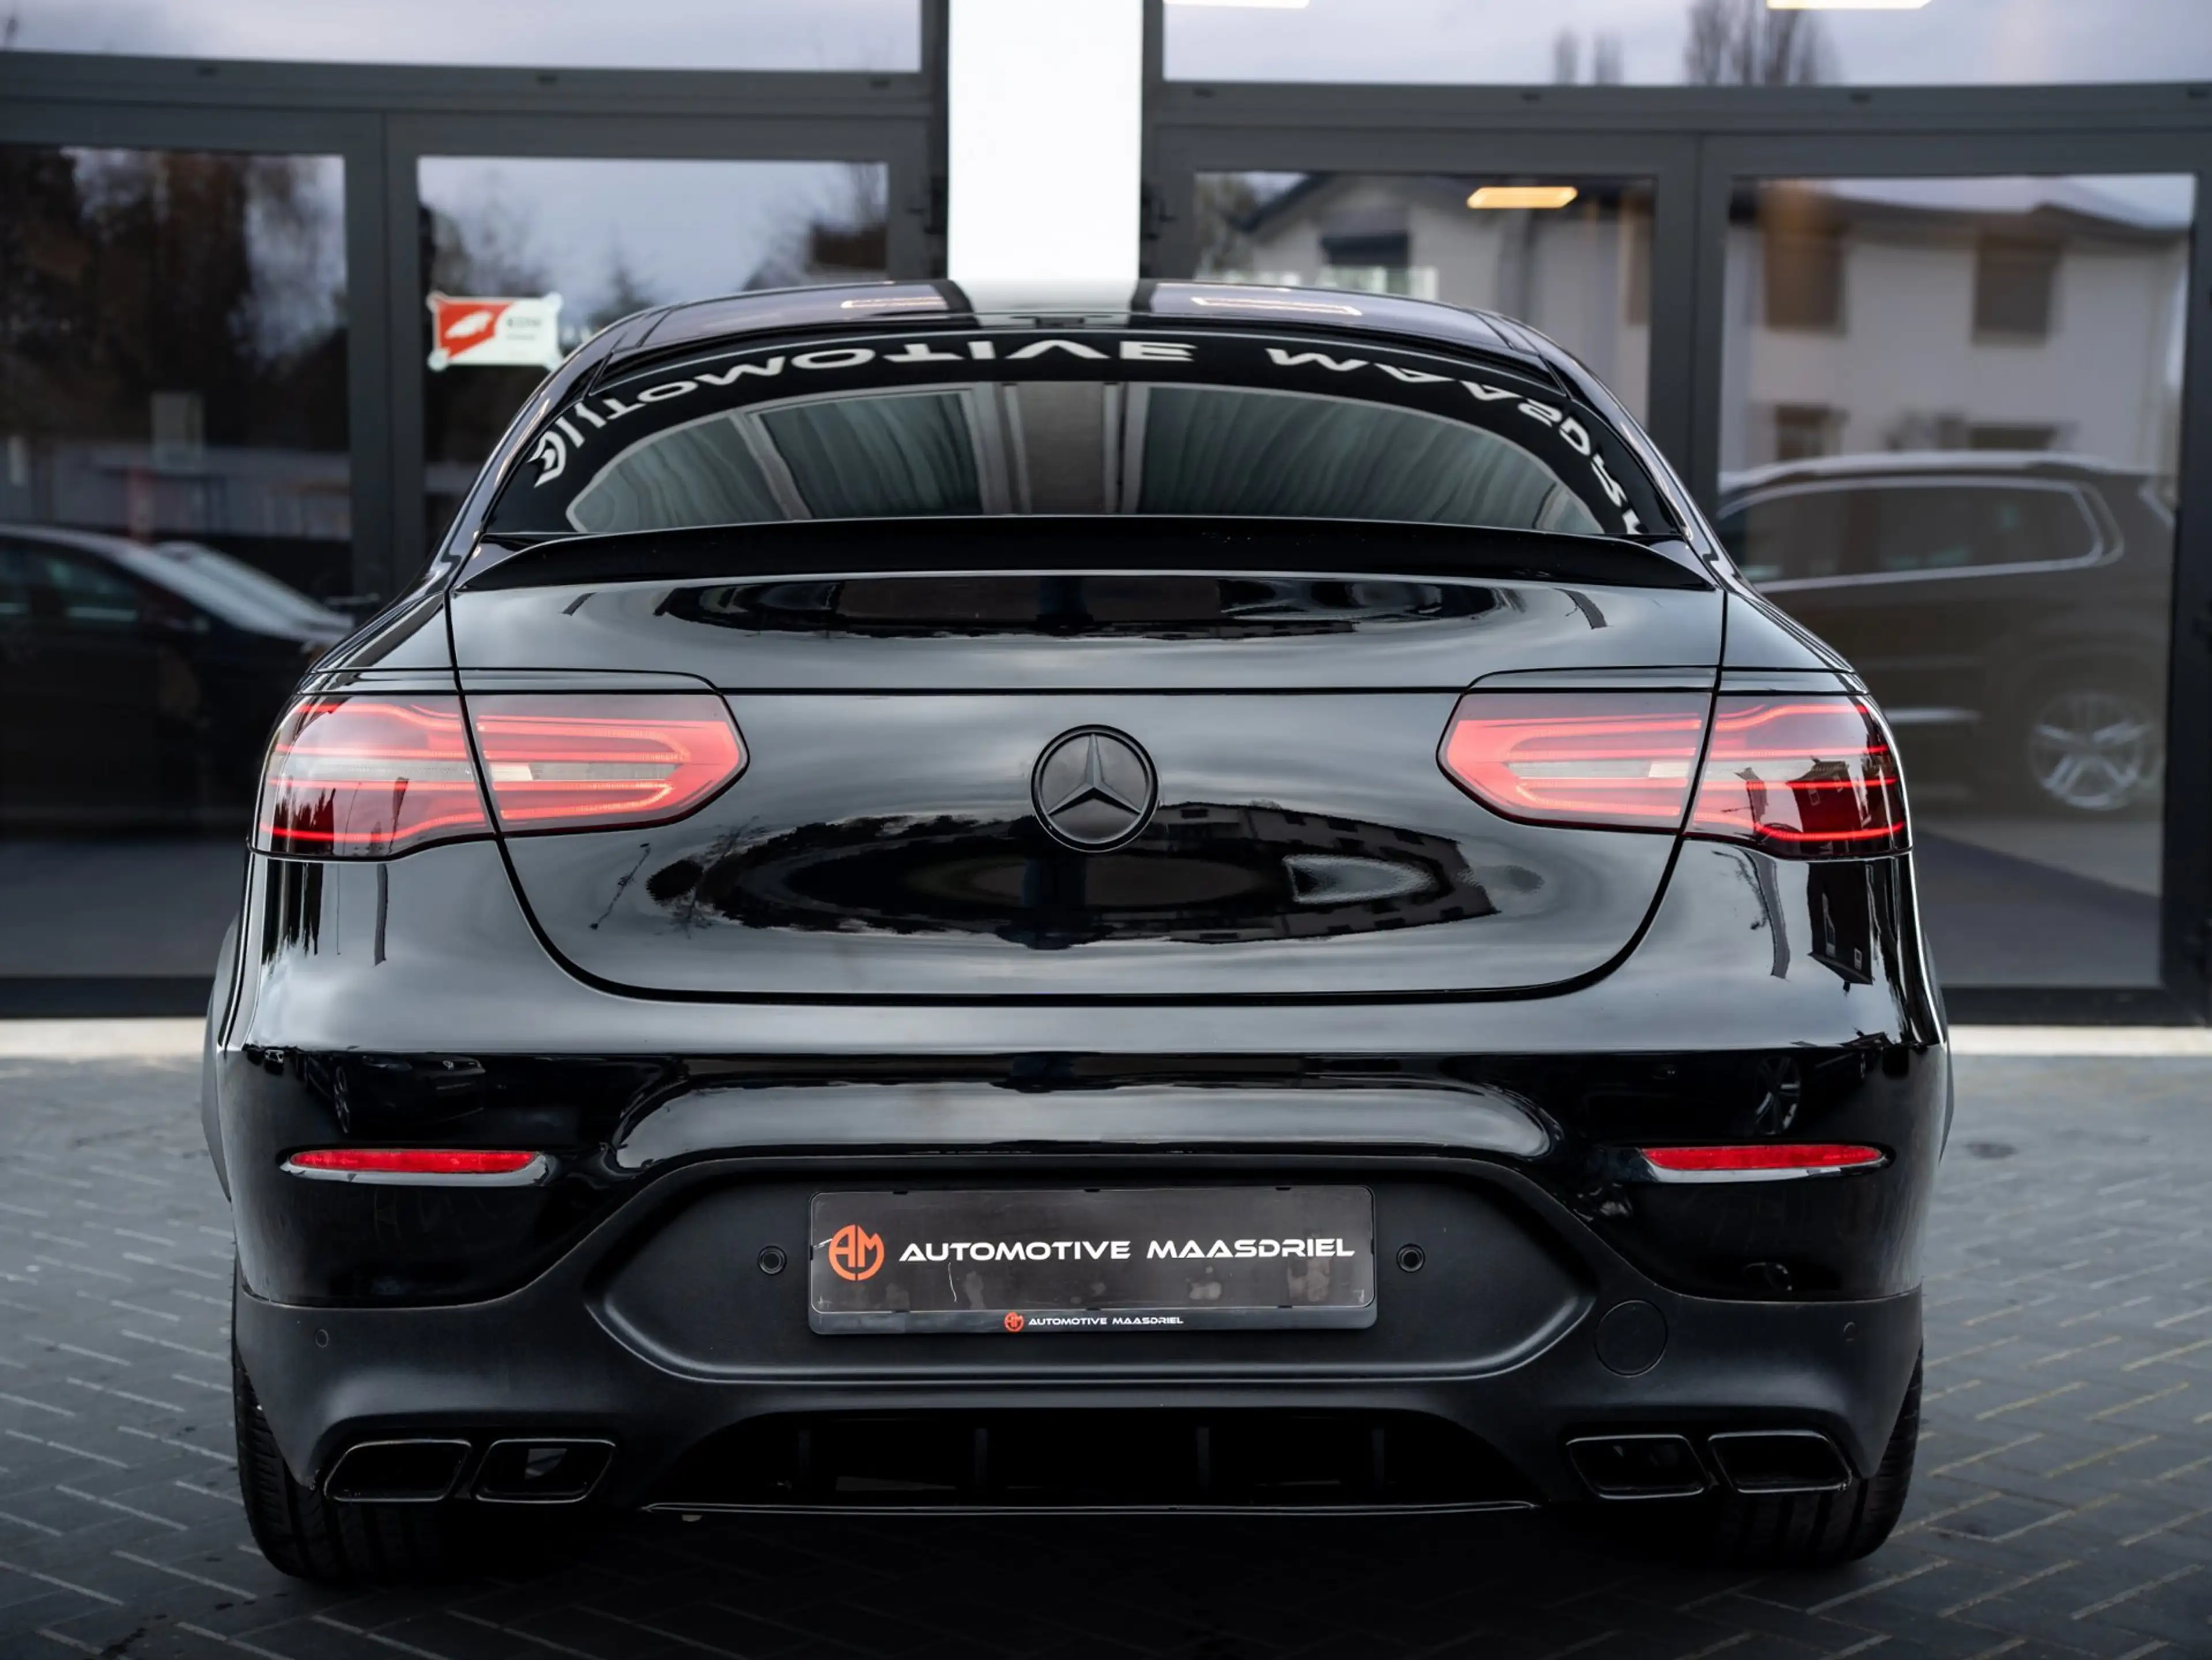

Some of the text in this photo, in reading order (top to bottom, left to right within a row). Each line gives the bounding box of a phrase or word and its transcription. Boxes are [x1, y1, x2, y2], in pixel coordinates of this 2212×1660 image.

[899, 1241, 1131, 1262] AUTOMOTIVE
[1146, 1238, 1355, 1259] MAASDRIEL
[1028, 1317, 1108, 1326] AUTOMOTIVE
[1112, 1316, 1184, 1325] MAASDRIEL
